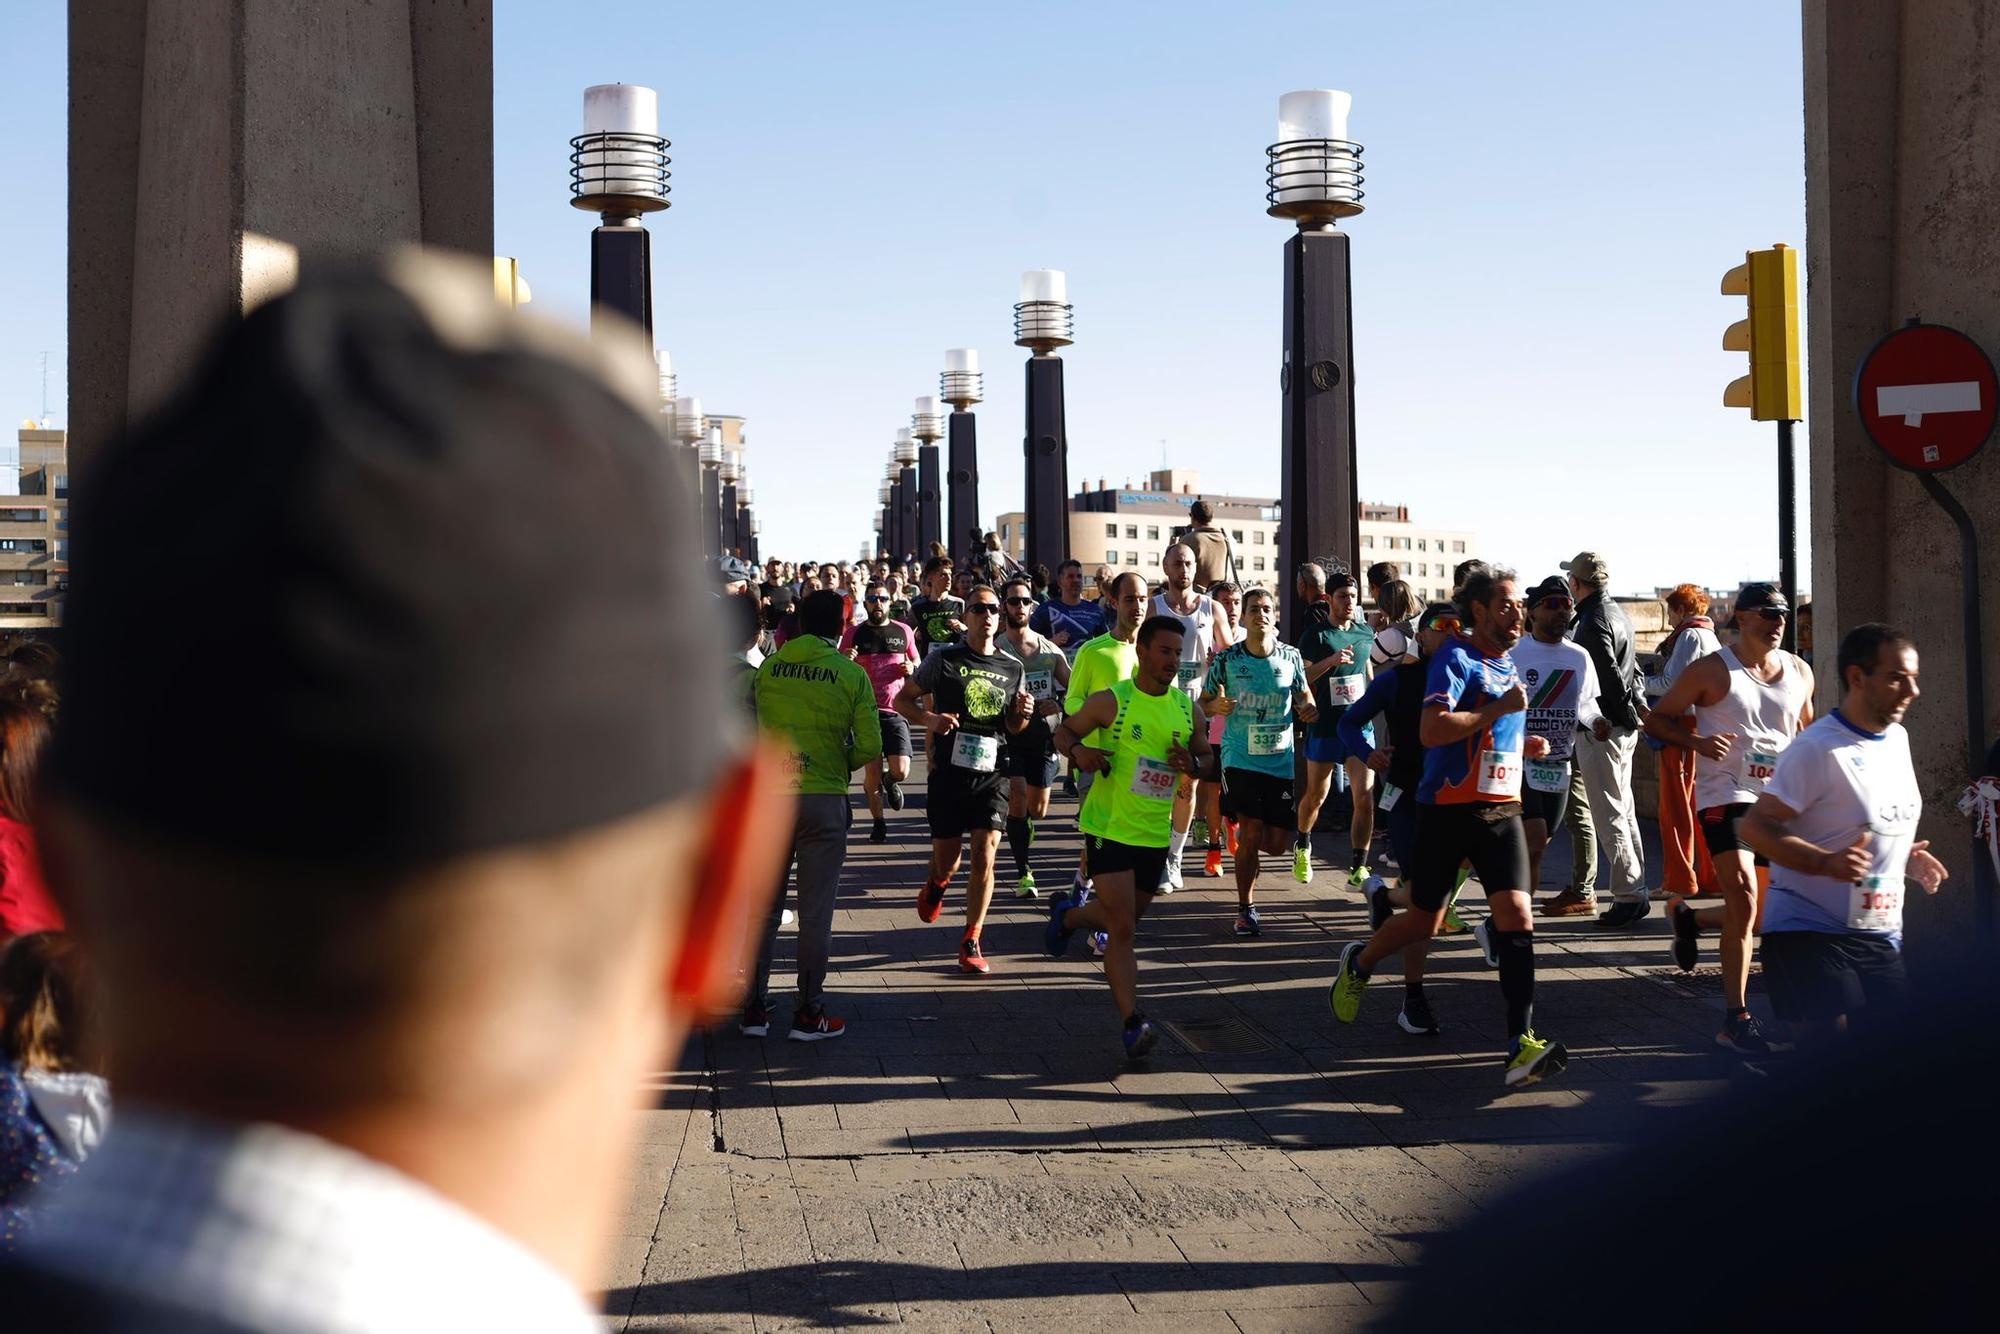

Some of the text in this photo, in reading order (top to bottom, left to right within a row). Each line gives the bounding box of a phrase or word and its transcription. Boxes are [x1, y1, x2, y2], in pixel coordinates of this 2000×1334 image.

[771, 663, 839, 684] SPORT&FUN
[970, 669, 1009, 682] SCOTT
[1526, 709, 1576, 718] FITNESS
[1551, 720, 1576, 731] GYM
